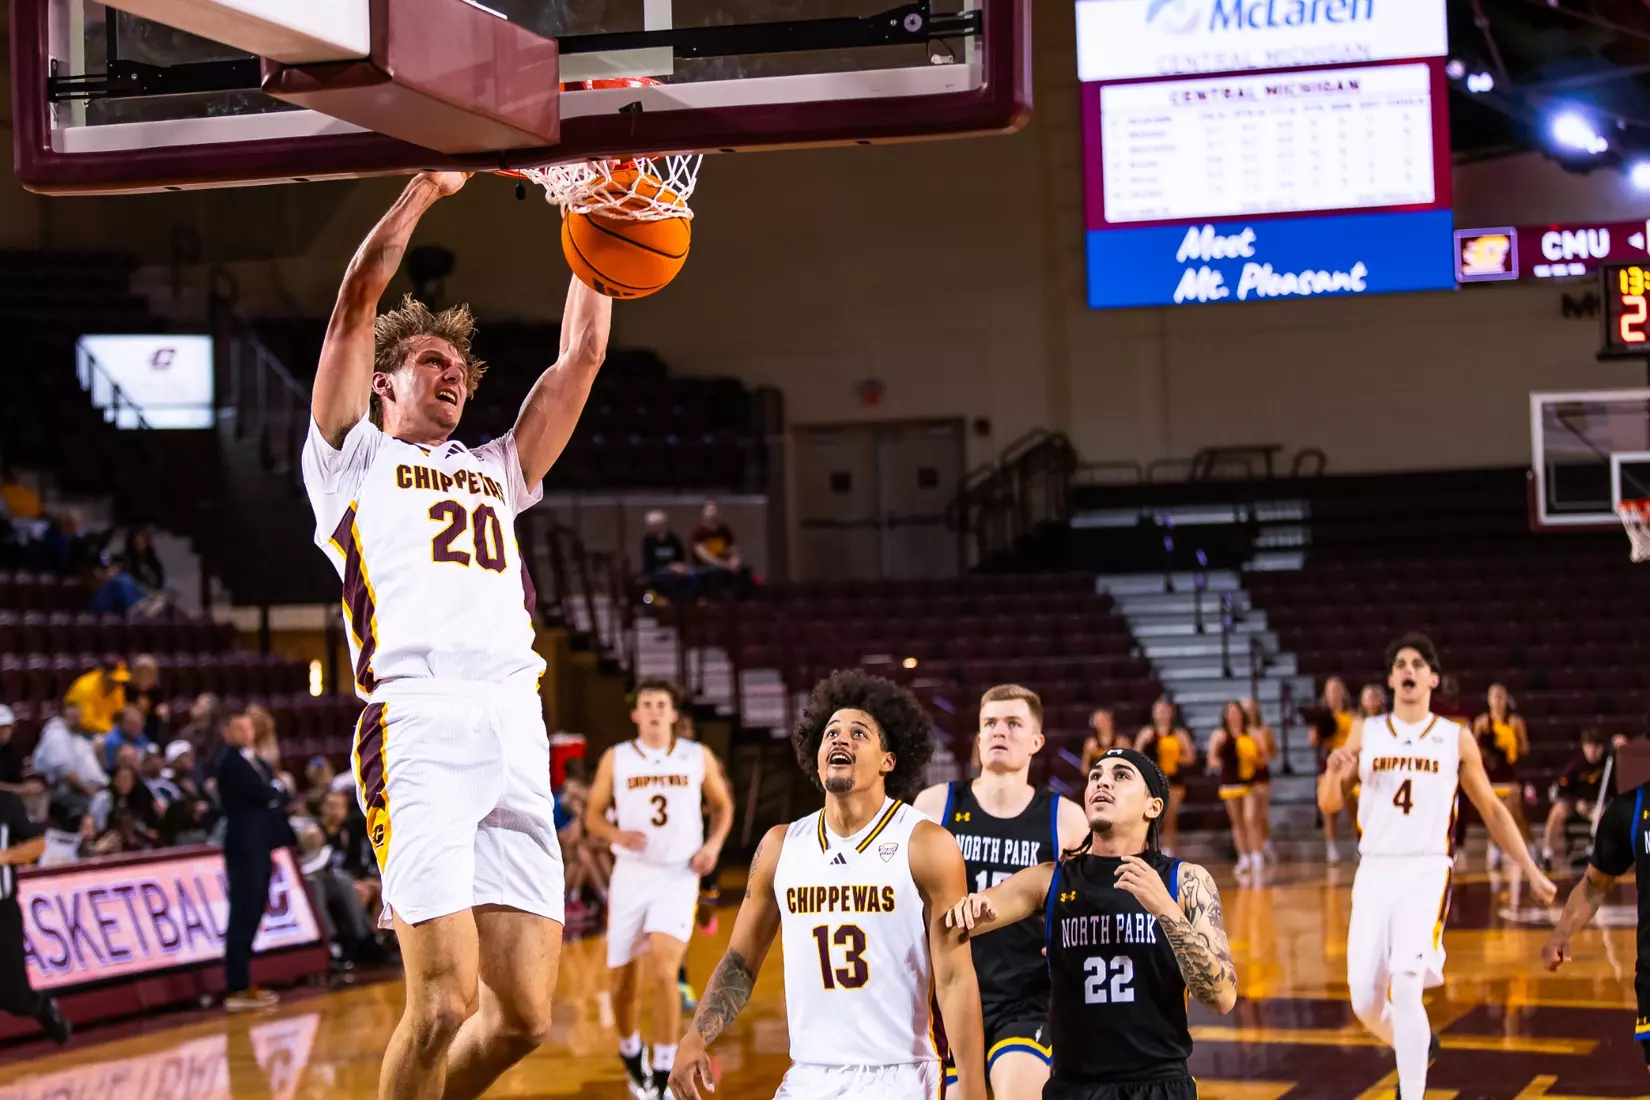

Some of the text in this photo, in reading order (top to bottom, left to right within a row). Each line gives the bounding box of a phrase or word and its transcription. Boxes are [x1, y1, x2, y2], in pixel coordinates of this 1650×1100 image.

[1176, 224, 1257, 263] Meet
[1542, 228, 1610, 261] CMU
[1237, 261, 1368, 301] Pleasant
[428, 499, 508, 574] 20
[1372, 757, 1439, 774] CHIPPEWAS
[650, 794, 669, 828] 3
[1392, 779, 1414, 815] 4
[955, 834, 1041, 867] NORTH PARK
[786, 885, 896, 914] CHIPPEWAS
[1061, 913, 1157, 949] NORTH PARK
[812, 923, 870, 990] 13
[1084, 955, 1135, 1004] 22
